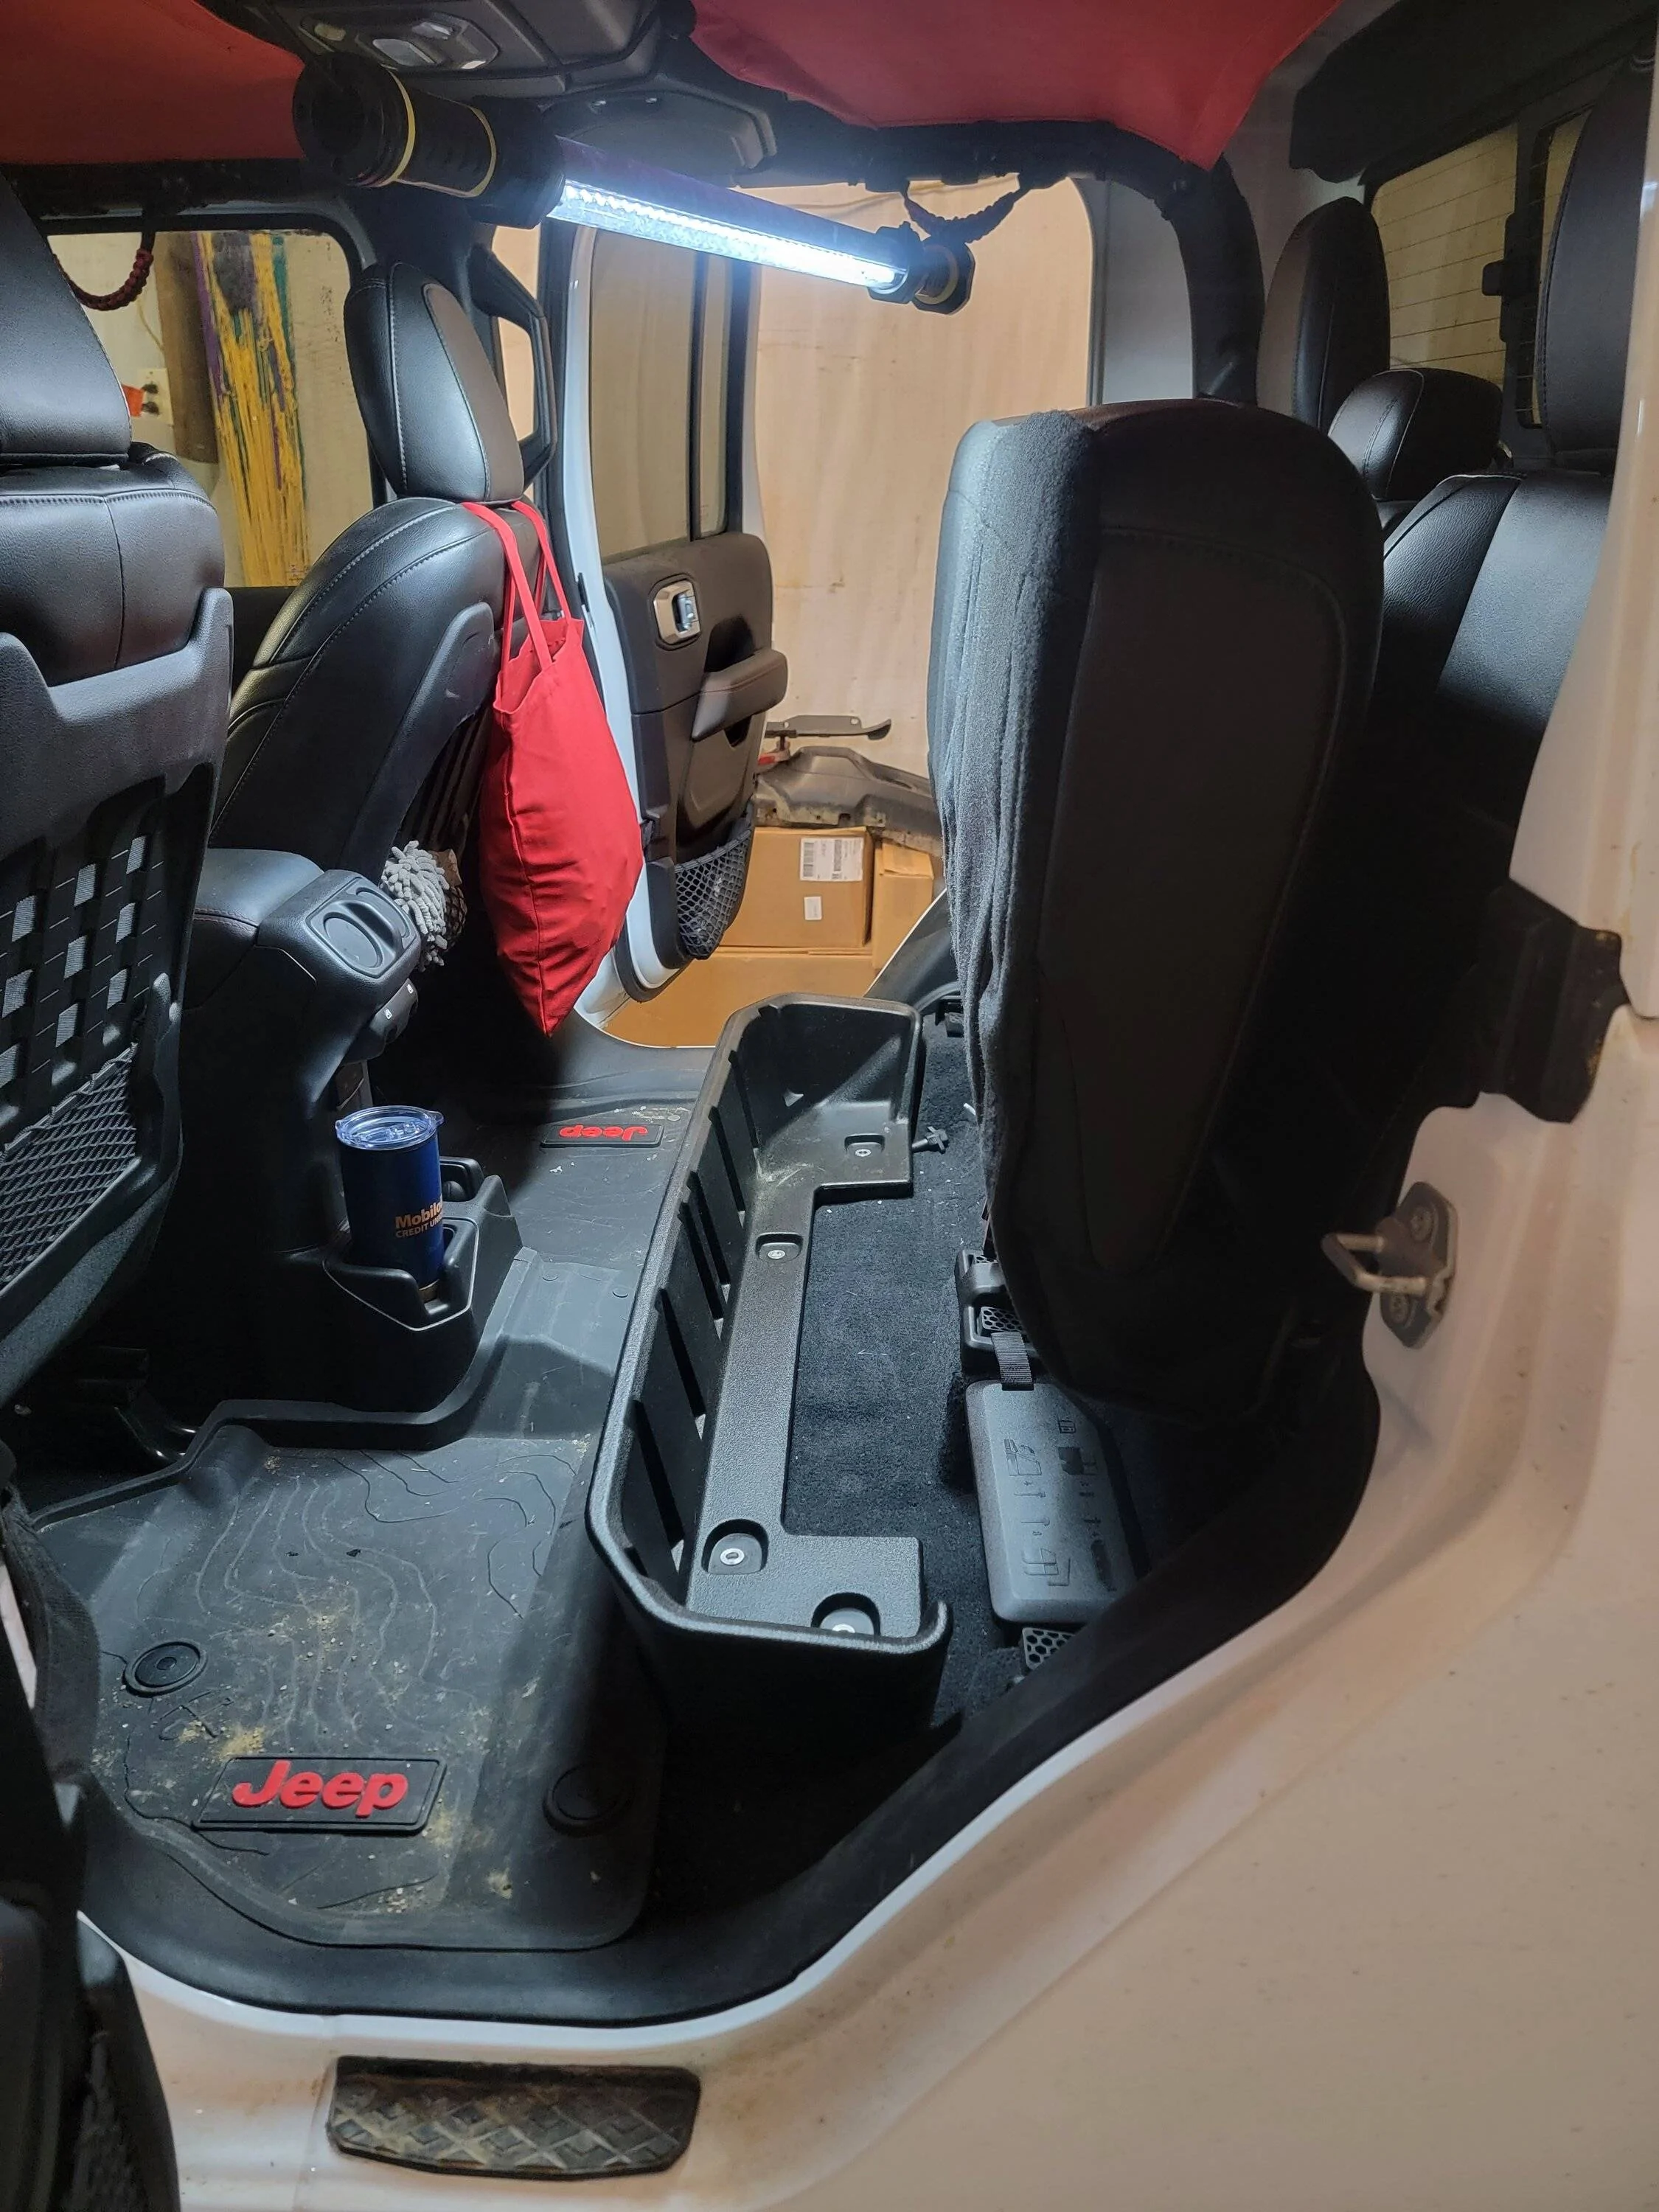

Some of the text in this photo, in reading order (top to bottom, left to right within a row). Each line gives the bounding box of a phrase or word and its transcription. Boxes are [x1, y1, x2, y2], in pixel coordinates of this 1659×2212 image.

[559, 1124, 648, 1141] Jeep
[394, 1202, 442, 1229] Mobilo
[396, 1223, 428, 1238] CREDIT
[232, 1759, 408, 1818] Jeep
